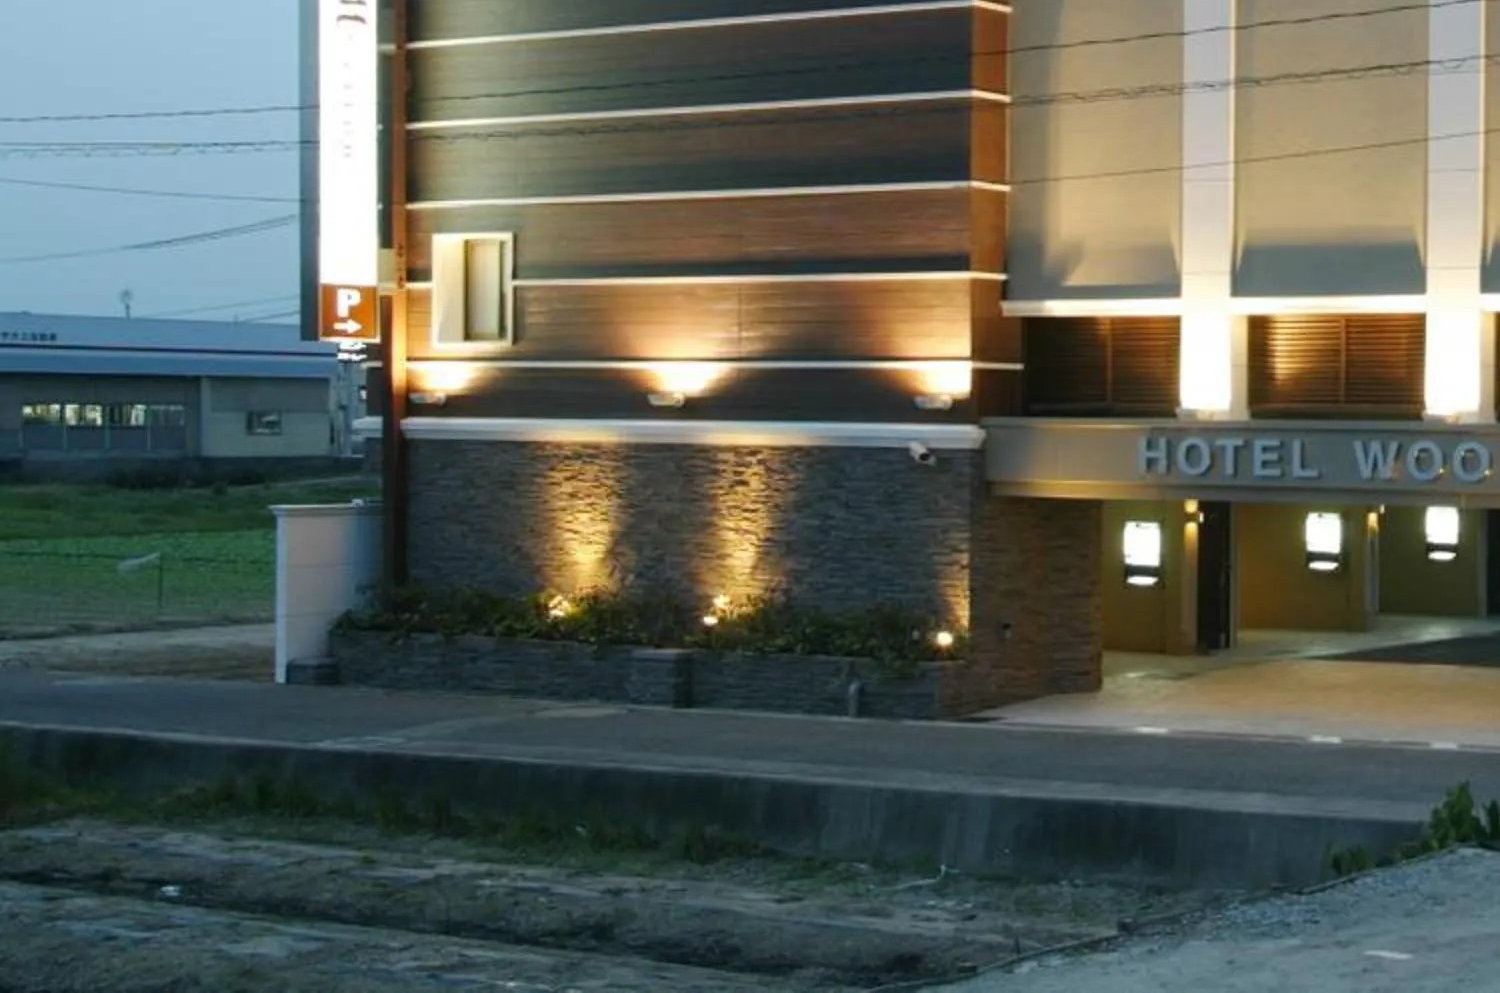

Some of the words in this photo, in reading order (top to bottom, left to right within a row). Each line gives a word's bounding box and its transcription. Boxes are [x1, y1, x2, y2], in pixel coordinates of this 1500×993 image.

[337, 288, 361, 318] P
[1137, 436, 1321, 480] HOTEL
[1352, 439, 1493, 483] WOO
